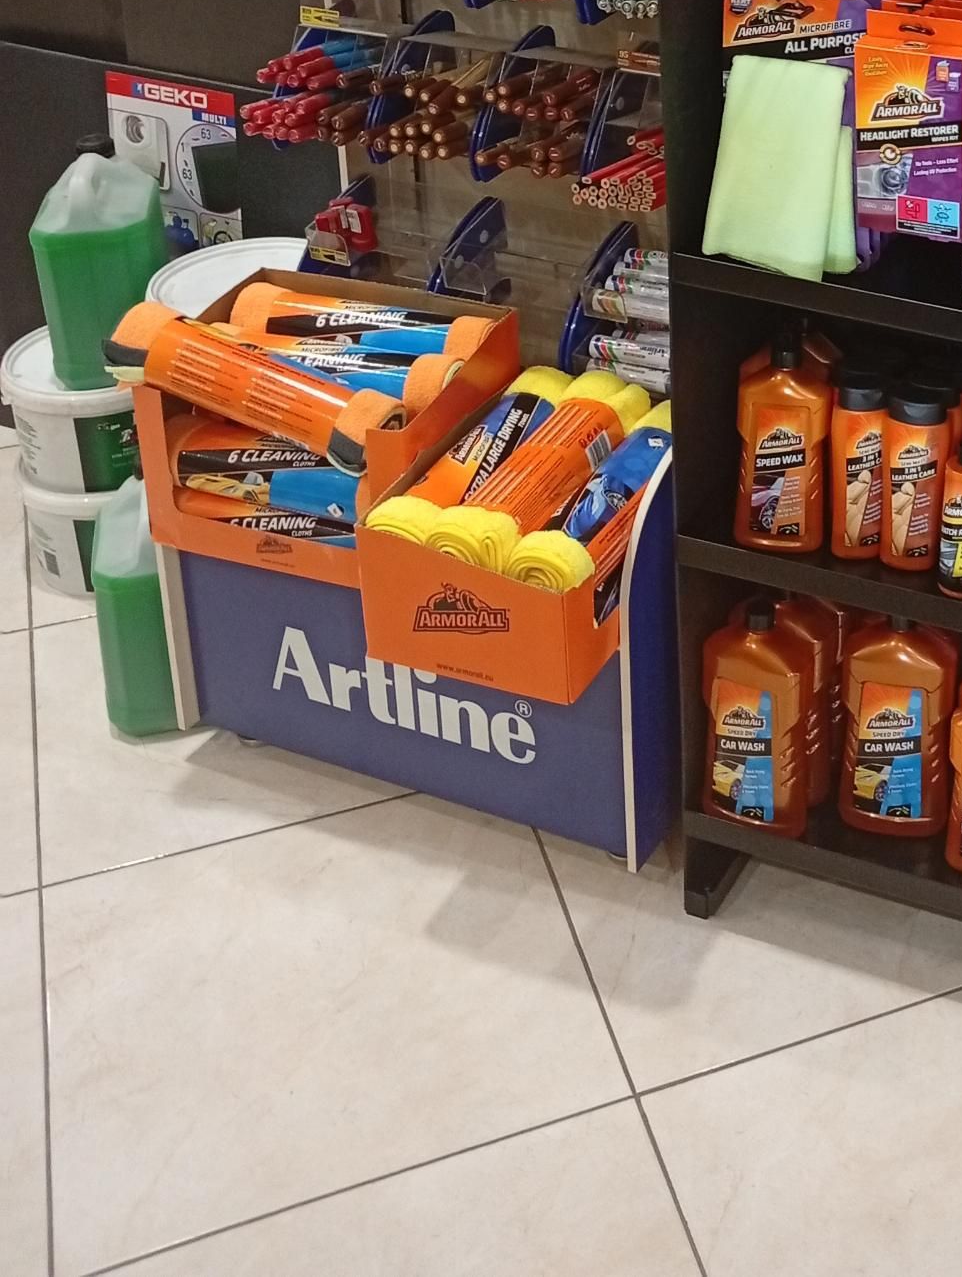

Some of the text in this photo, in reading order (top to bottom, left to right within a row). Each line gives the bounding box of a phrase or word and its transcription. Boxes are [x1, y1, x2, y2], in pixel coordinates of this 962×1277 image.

[799, 19, 853, 34] MICROFIBRE
[784, 40, 809, 54] ALL
[143, 83, 208, 109] GEKO
[201, 112, 227, 125] MULTI
[200, 128, 212, 140] 63
[859, 124, 960, 143] HEADLIGHT RESTORER
[182, 168, 193, 181] 63
[315, 313, 327, 328] 6
[484, 438, 507, 473] LARGE
[500, 407, 523, 441] DRYING
[227, 449, 242, 464] 6
[755, 454, 804, 468] SPEED WAX
[847, 462, 875, 472] LEATHER
[891, 472, 918, 481] LEATHER
[242, 516, 319, 531] CLEANING
[291, 529, 313, 537] CLOTHS
[272, 626, 536, 764] Artline
[720, 739, 766, 752] CAR WASH
[864, 741, 914, 753] CAR WASH
